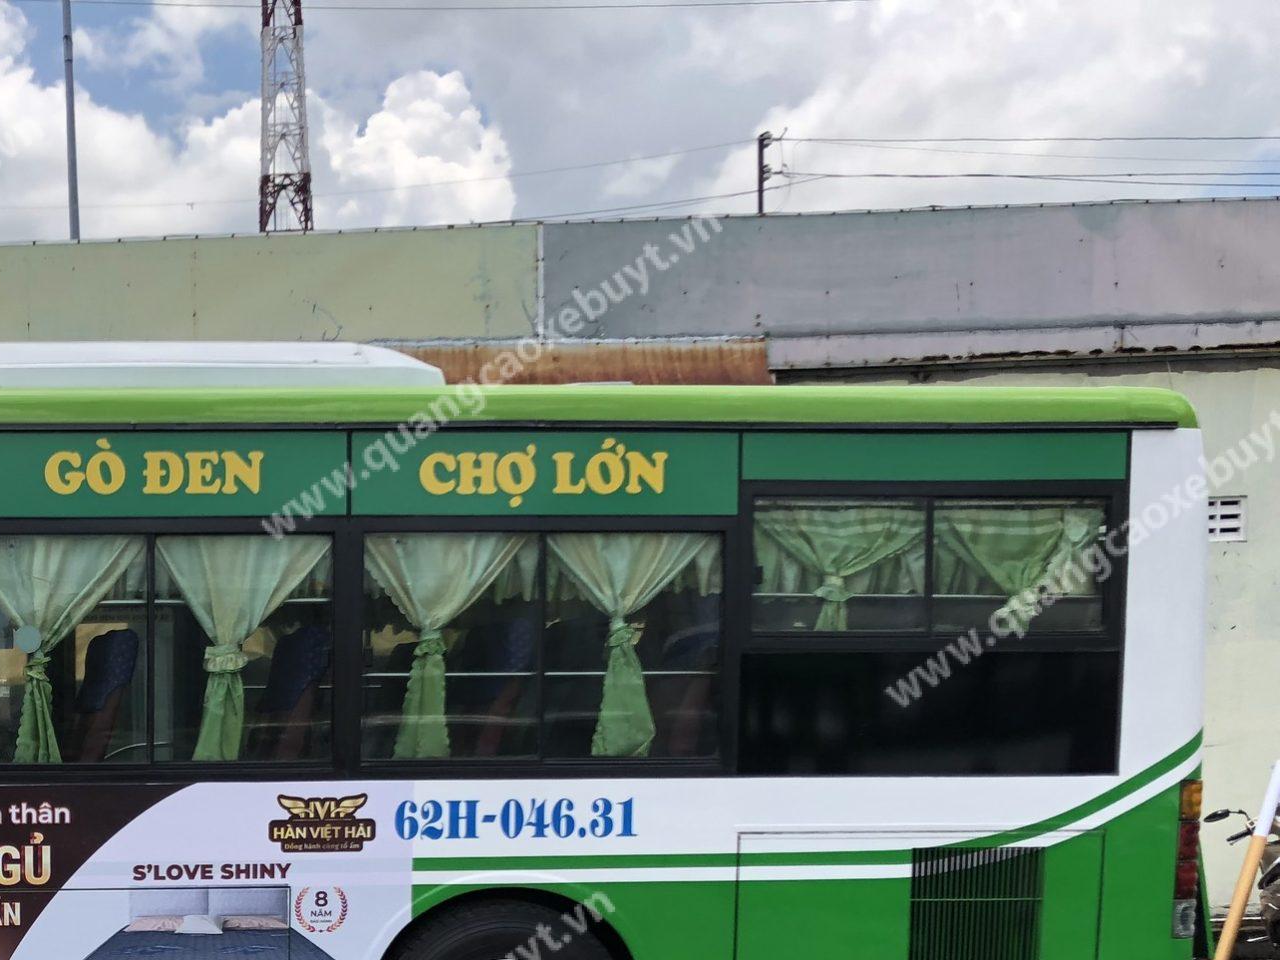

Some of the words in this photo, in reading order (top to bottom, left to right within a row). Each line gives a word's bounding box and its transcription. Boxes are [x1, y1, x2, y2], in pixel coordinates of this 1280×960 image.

[44, 437, 126, 495] GÒ
[142, 451, 264, 495] ĐEN
[419, 443, 537, 508] CHỢ
[552, 437, 669, 495] LỚN
[9, 801, 71, 825] thân
[394, 796, 639, 841] 62H-046.31
[273, 824, 306, 840] HÀN
[309, 824, 341, 841] VIỆT
[344, 823, 371, 839] HẢI
[220, 863, 291, 880] SHINY
[315, 891, 328, 907] 8
[310, 908, 332, 917] NĂM
